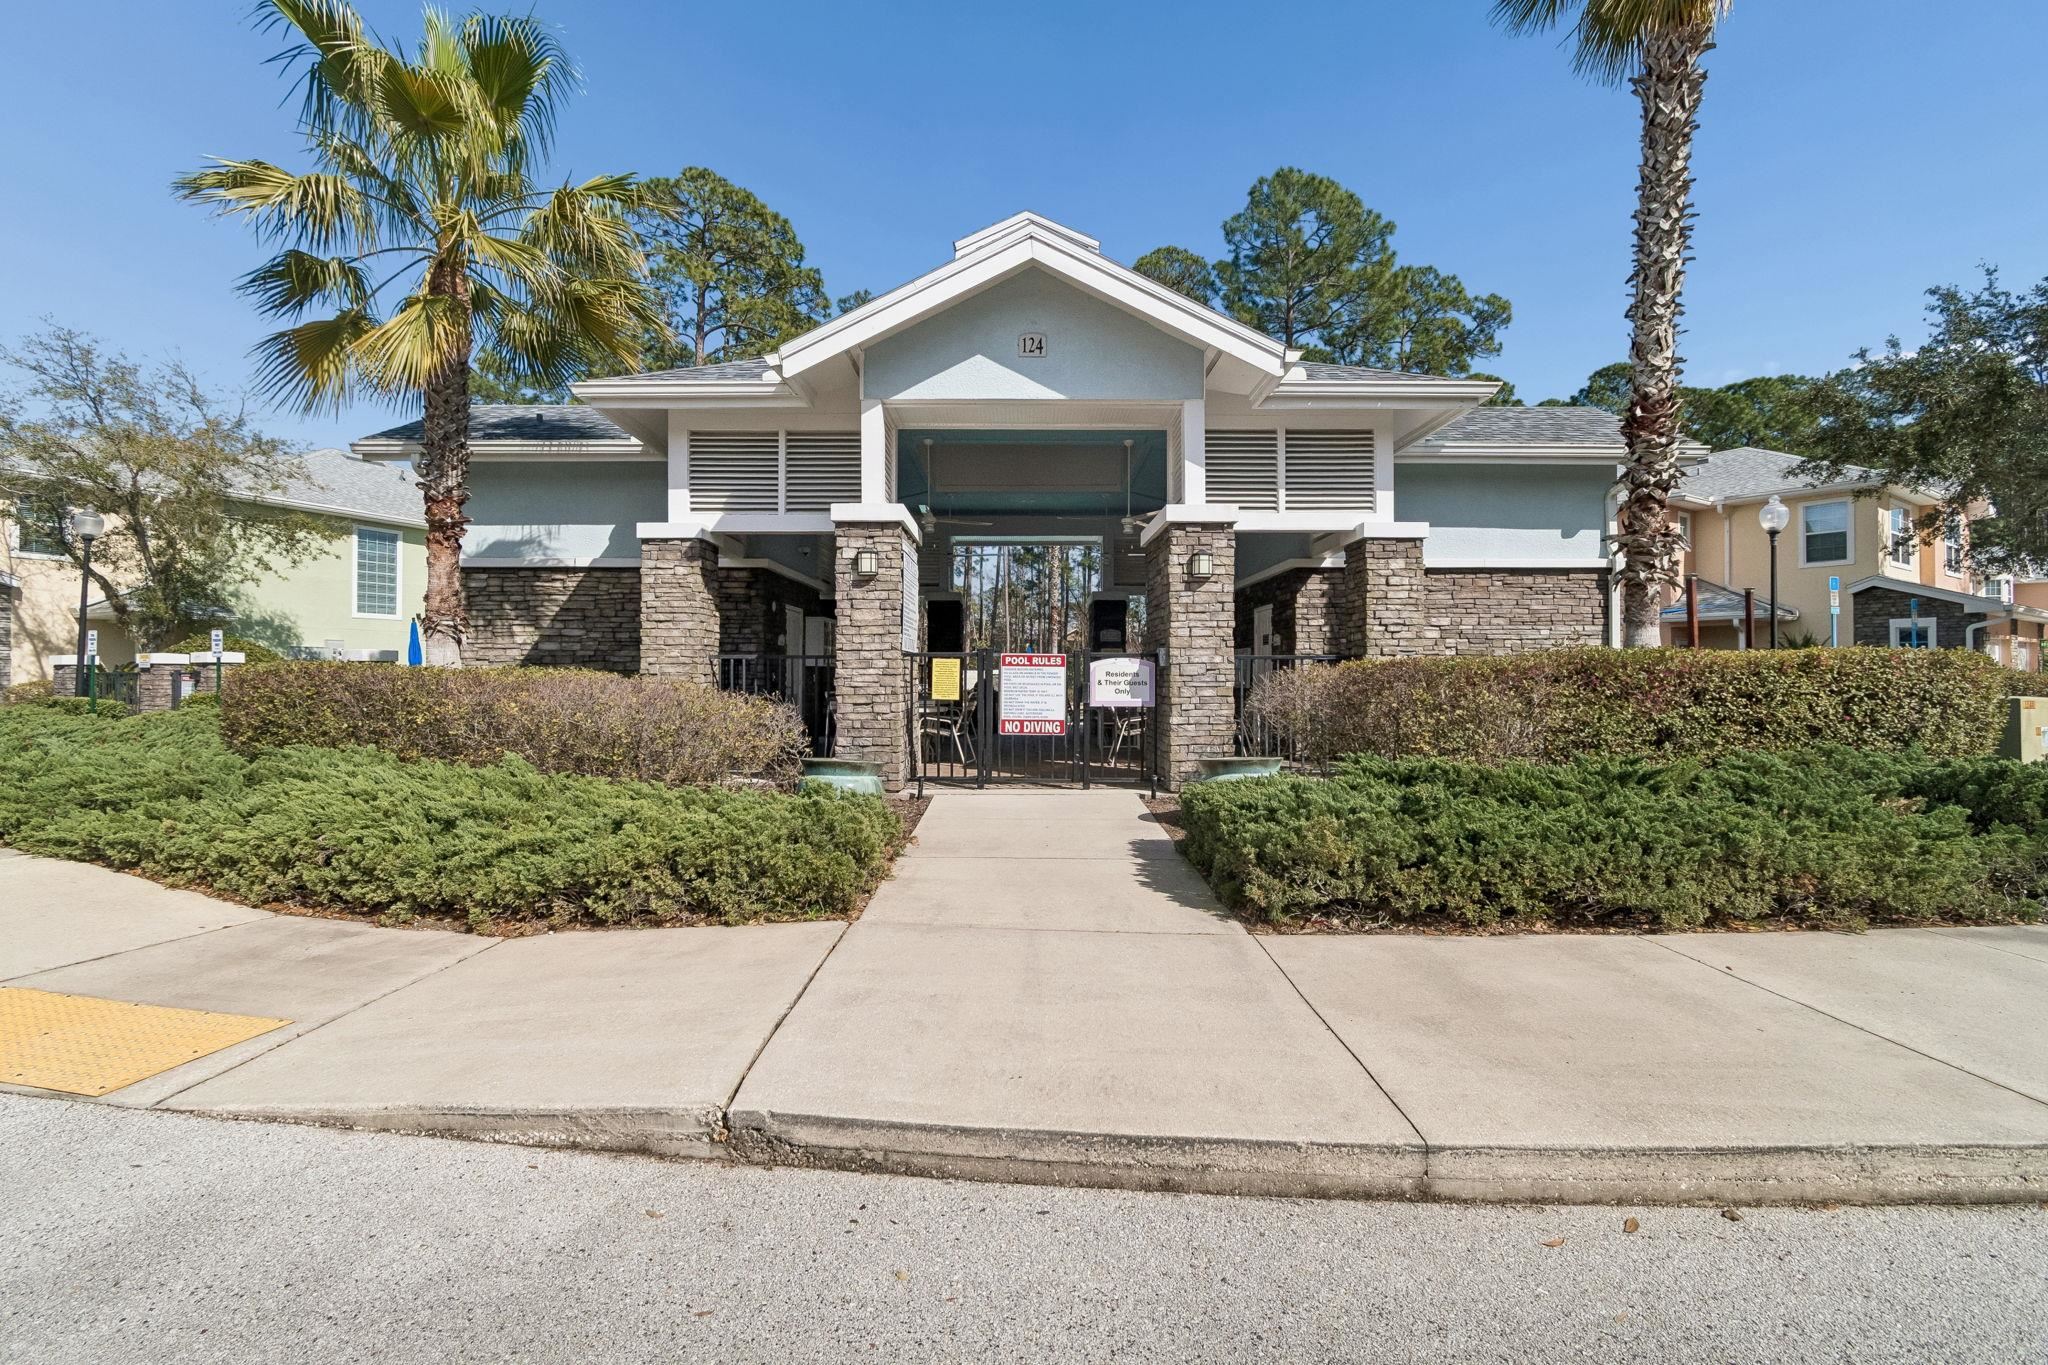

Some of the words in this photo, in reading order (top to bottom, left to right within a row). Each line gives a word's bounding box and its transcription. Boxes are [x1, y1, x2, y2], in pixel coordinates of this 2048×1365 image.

[1022, 337, 1043, 354] 124
[1005, 656, 1030, 665] POOL
[1032, 656, 1062, 665] RULES
[1105, 670, 1140, 678] Residents
[1114, 688, 1131, 696] Only
[1004, 720, 1020, 733] NO
[1023, 721, 1061, 733] DIVING
